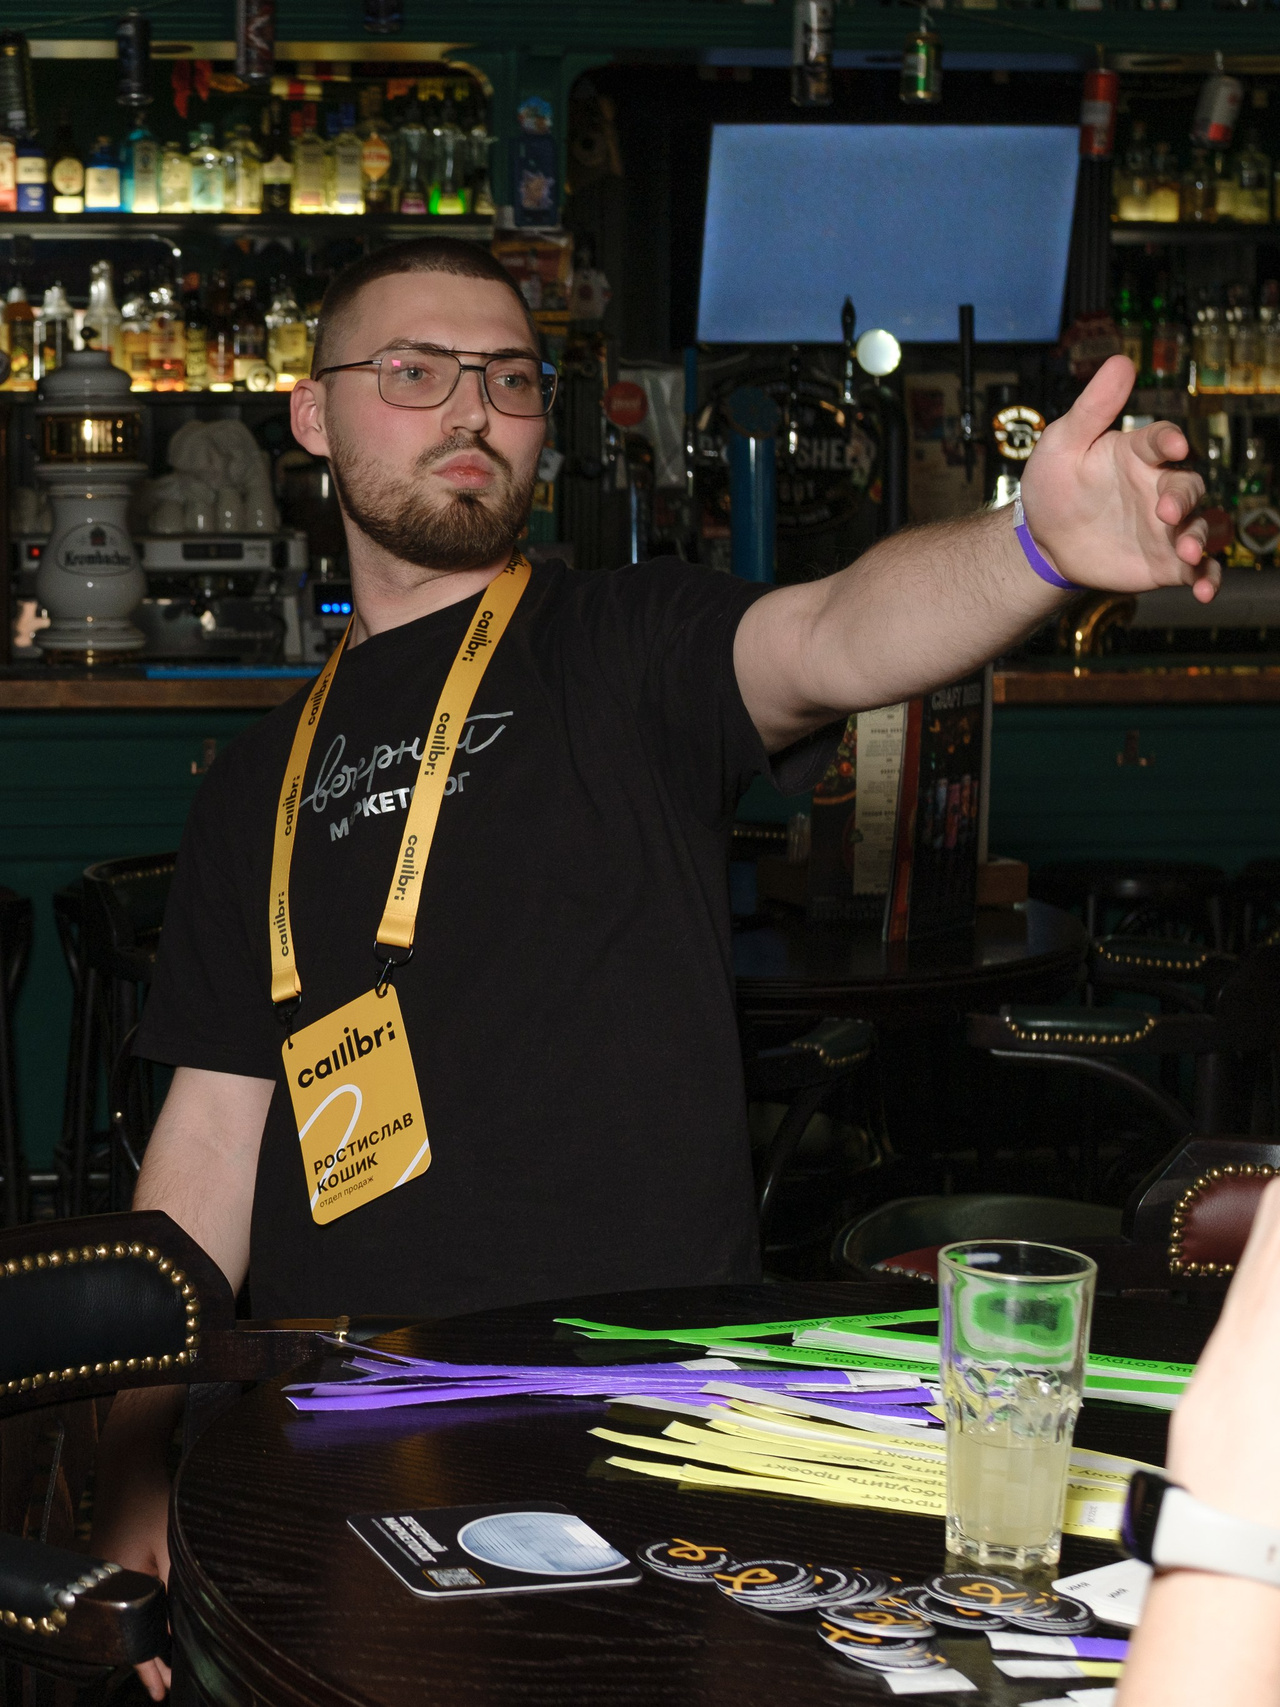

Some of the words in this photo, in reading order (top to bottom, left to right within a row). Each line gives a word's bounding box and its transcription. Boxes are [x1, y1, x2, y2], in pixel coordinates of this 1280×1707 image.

[313, 1112, 414, 1175] РОСТИСЛАВ
[317, 1152, 379, 1195] КОШИК
[319, 1191, 343, 1208] отдел
[343, 1175, 375, 1196] продаж
[761, 1462, 841, 1481] проект
[816, 1453, 896, 1468] проект
[859, 1493, 944, 1509] проект
